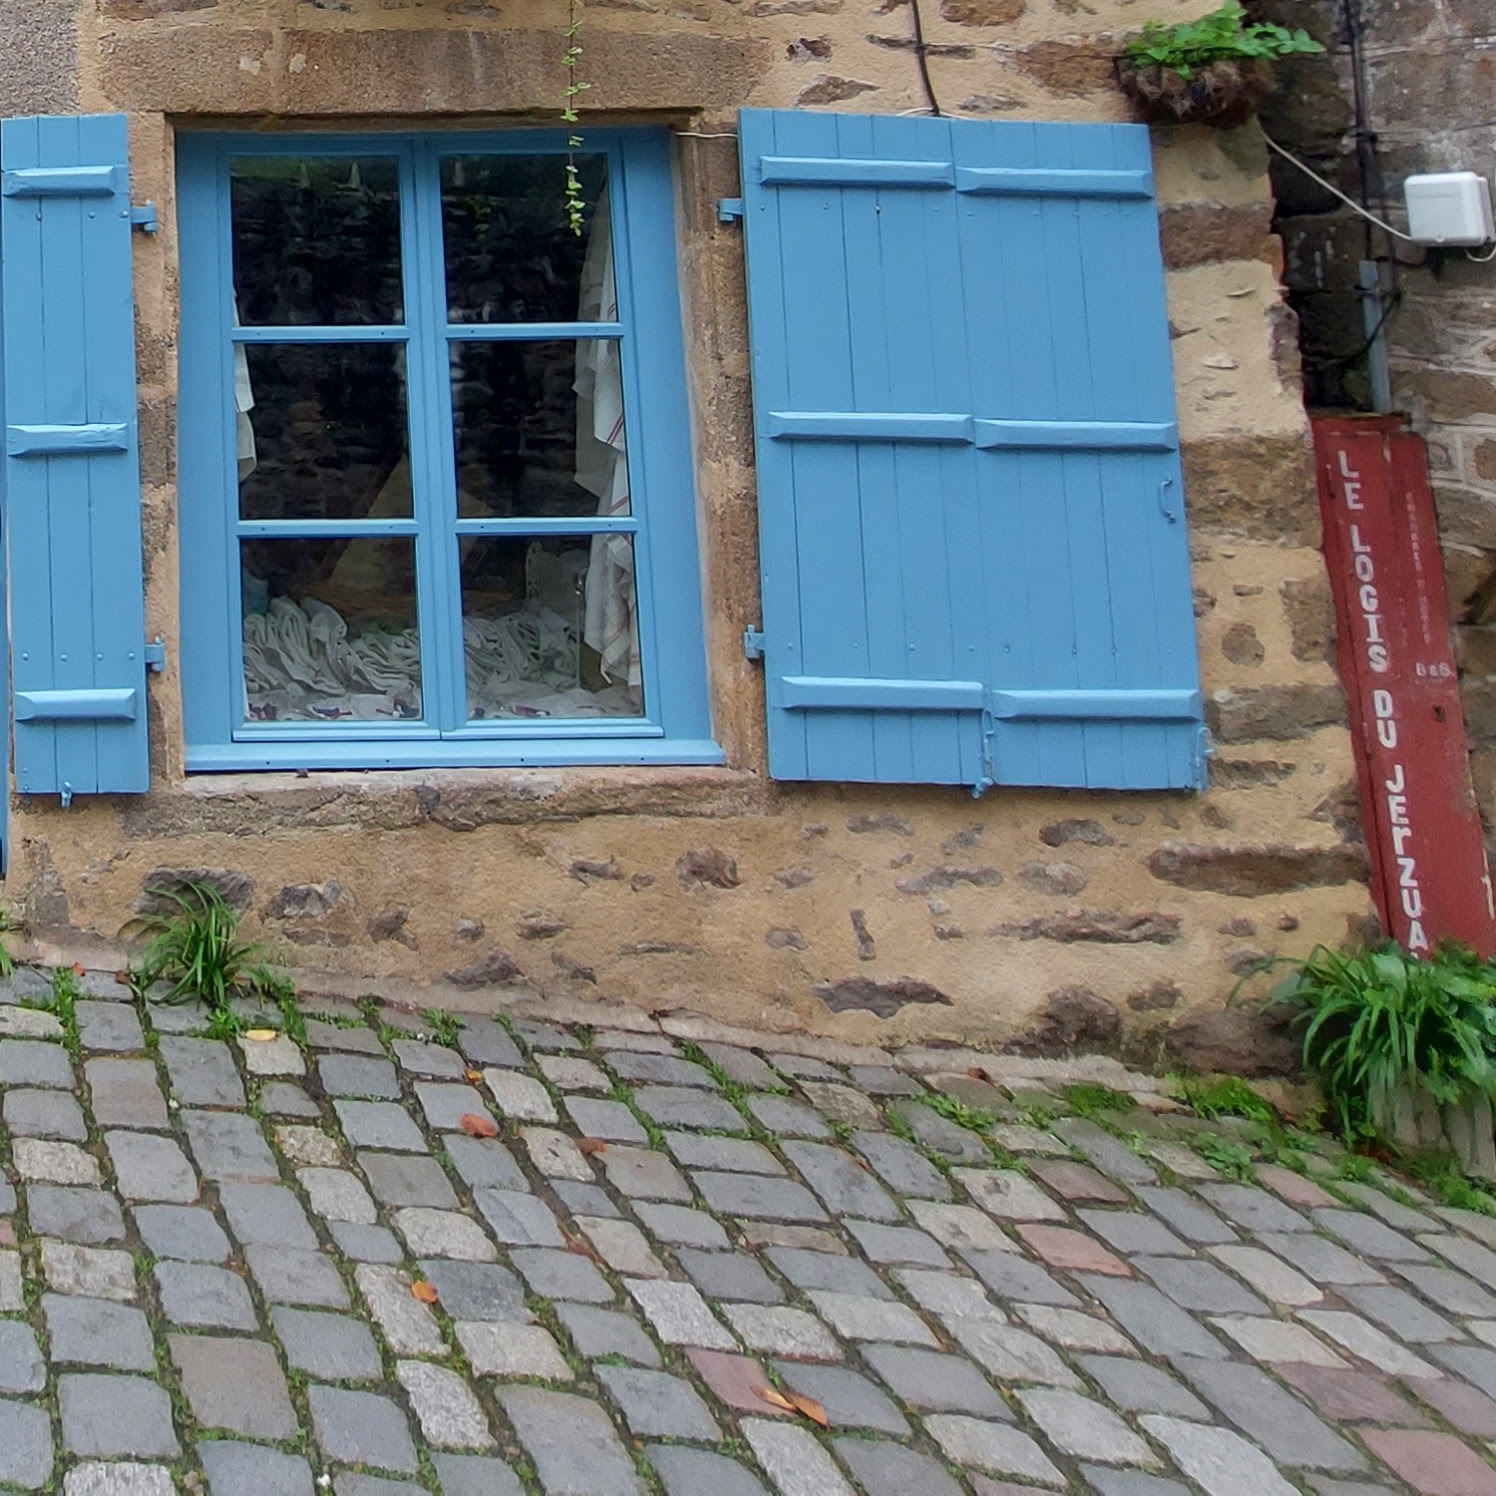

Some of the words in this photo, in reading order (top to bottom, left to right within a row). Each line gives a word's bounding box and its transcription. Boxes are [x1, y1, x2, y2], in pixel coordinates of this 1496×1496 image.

[1338, 450, 1364, 510] LE
[1350, 524, 1390, 673] LOGIS
[1415, 661, 1451, 677] B&B
[1373, 688, 1398, 749] DU
[1385, 764, 1429, 960] JERZUA
